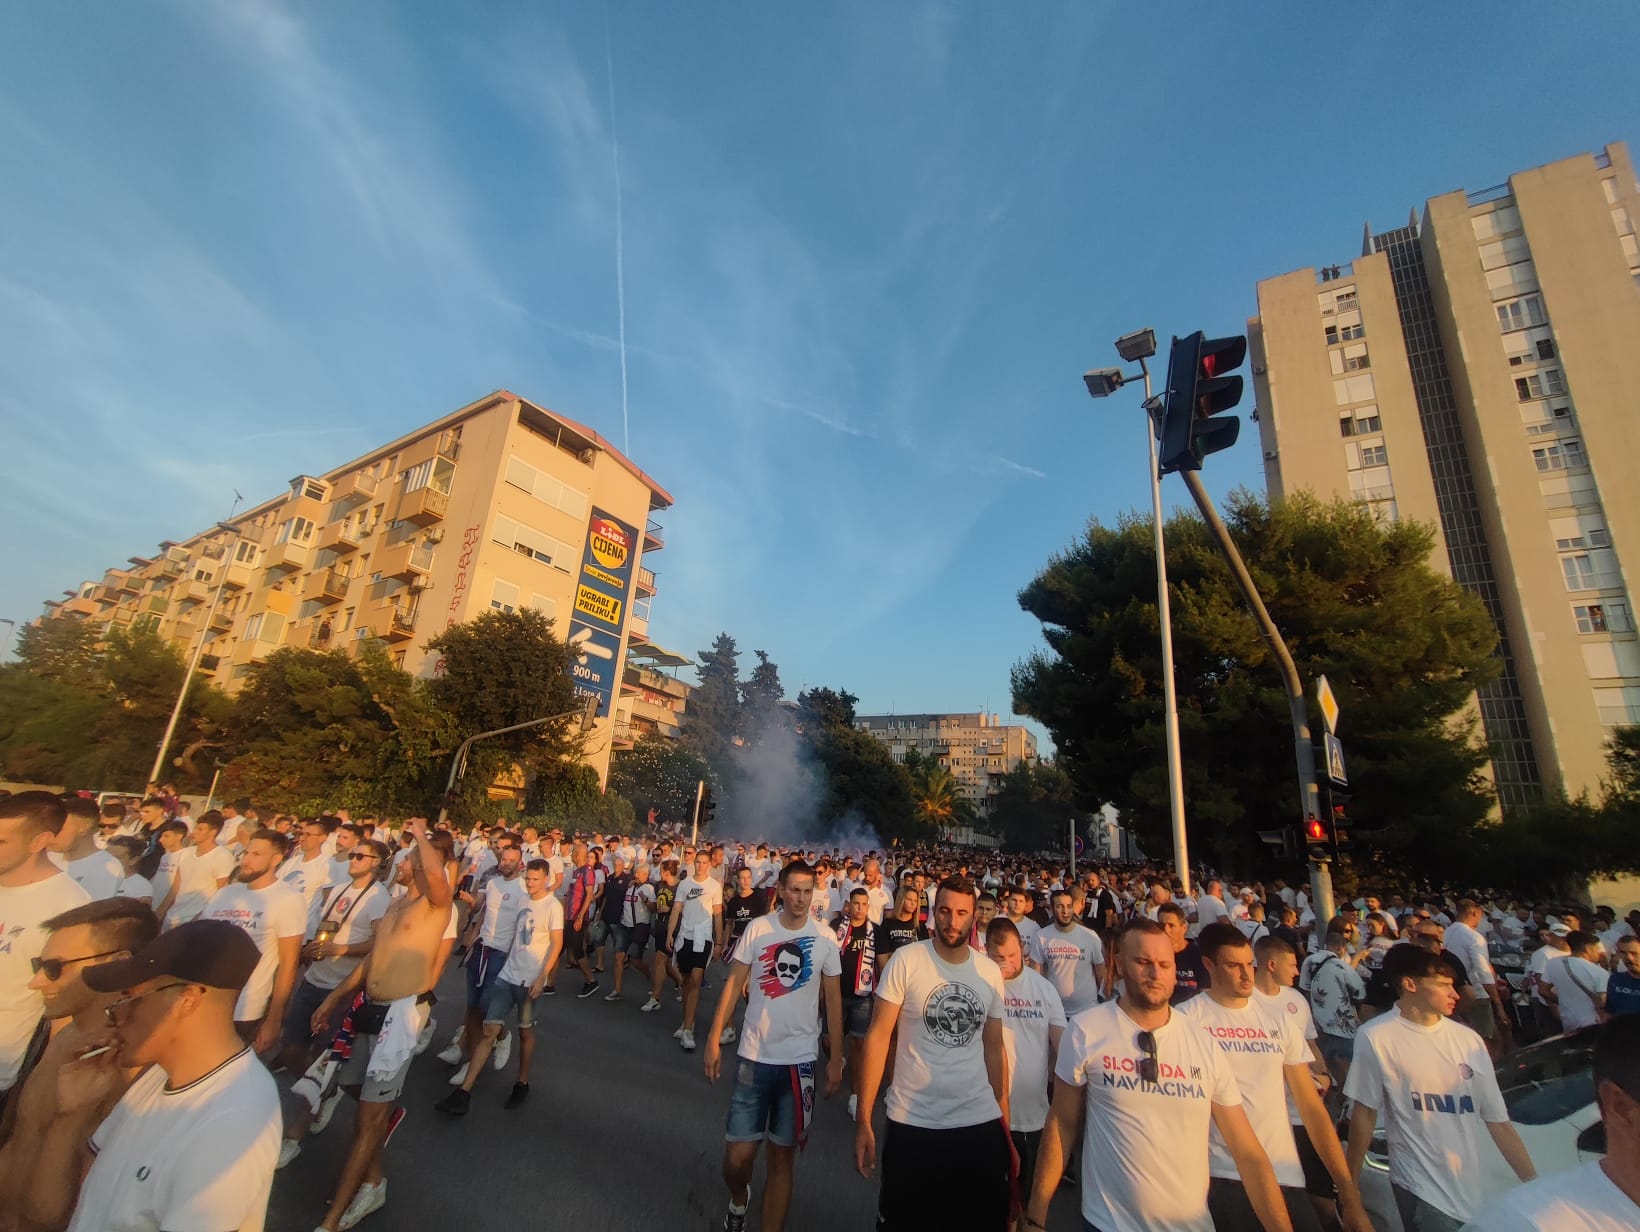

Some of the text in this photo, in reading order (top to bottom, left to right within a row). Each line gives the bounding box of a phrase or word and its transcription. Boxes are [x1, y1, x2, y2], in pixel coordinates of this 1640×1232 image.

[600, 526, 625, 545] LIDL
[593, 536, 623, 560] CIJENA
[580, 589, 610, 607] UGRABI
[579, 599, 610, 618] PRILIKU
[573, 664, 600, 683] 900 m
[1103, 1055, 1186, 1079] SLODA
